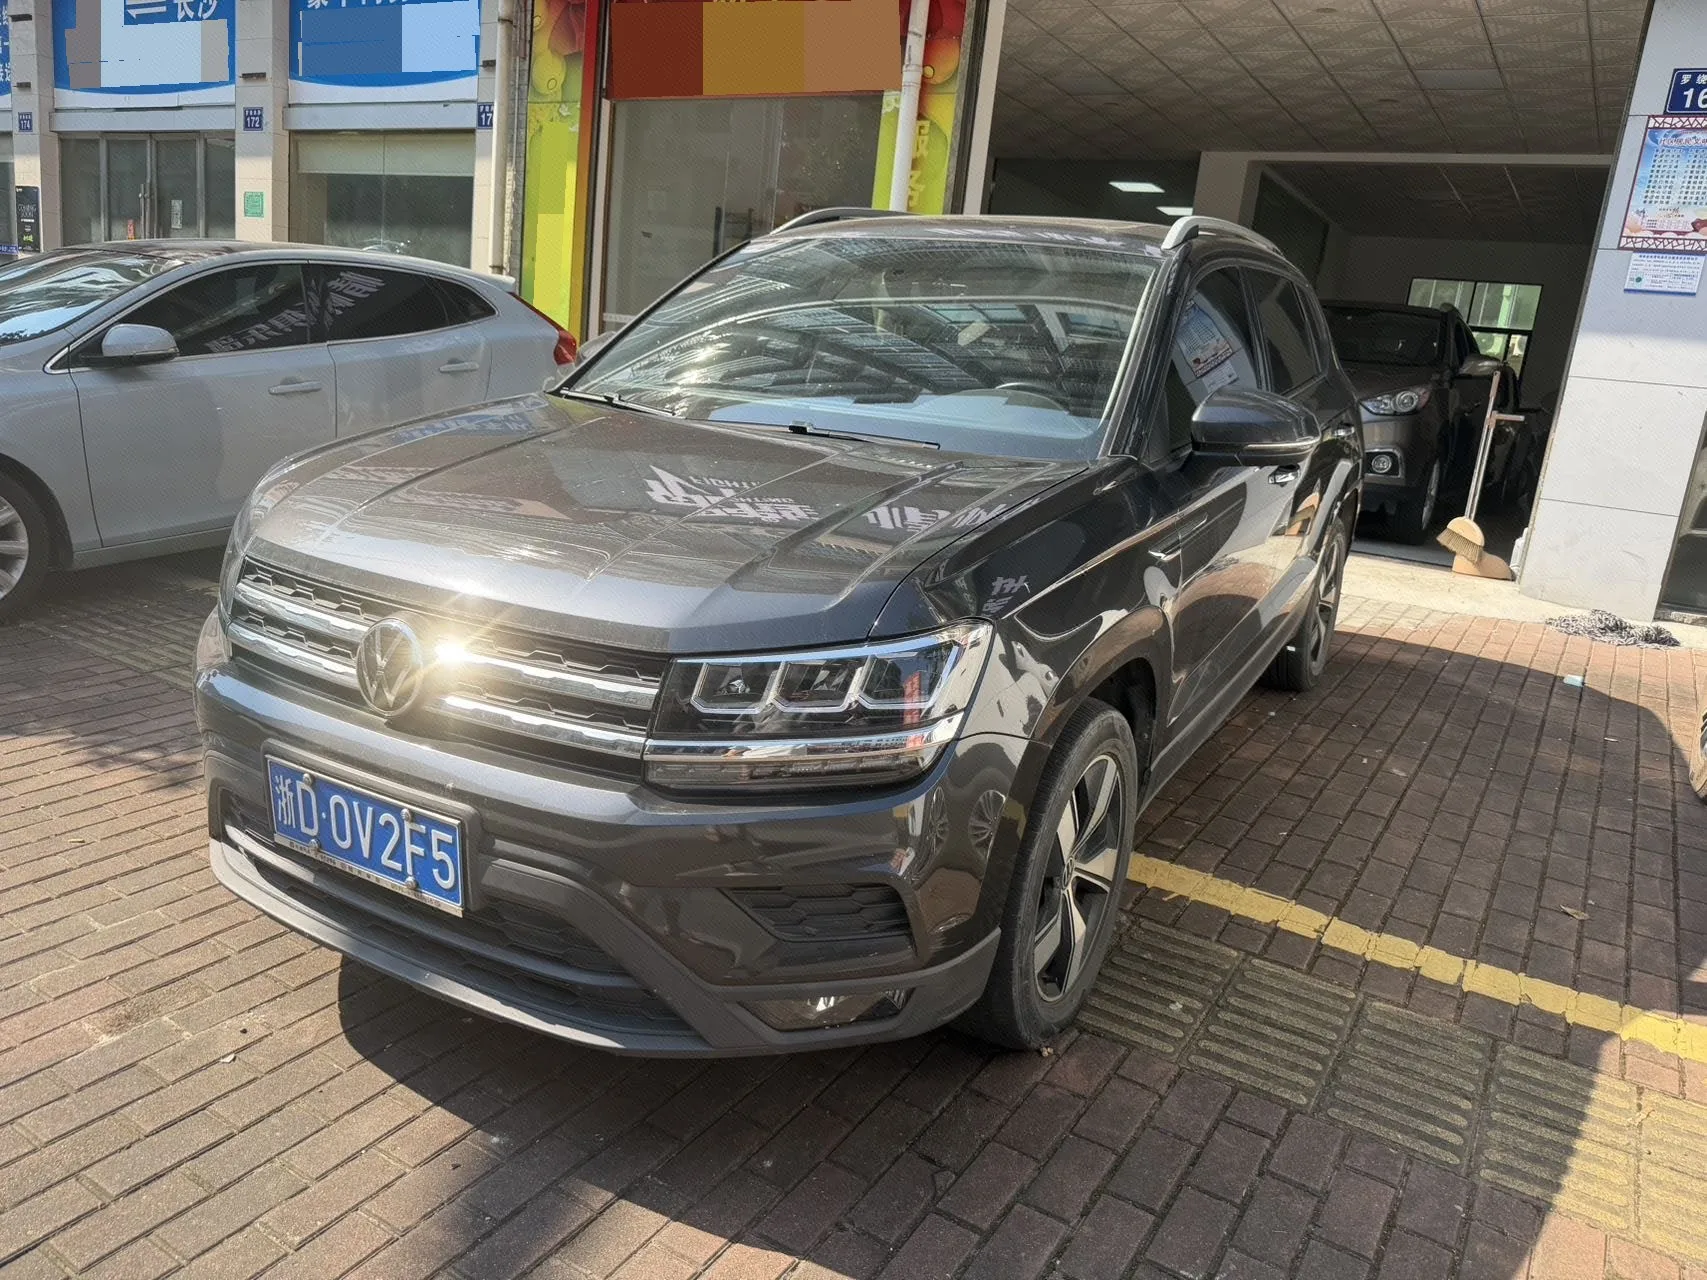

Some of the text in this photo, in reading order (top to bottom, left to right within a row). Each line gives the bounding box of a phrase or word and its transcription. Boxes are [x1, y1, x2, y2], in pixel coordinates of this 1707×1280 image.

[20, 119, 30, 130] 174
[247, 116, 260, 128] 172
[481, 112, 493, 126] 17
